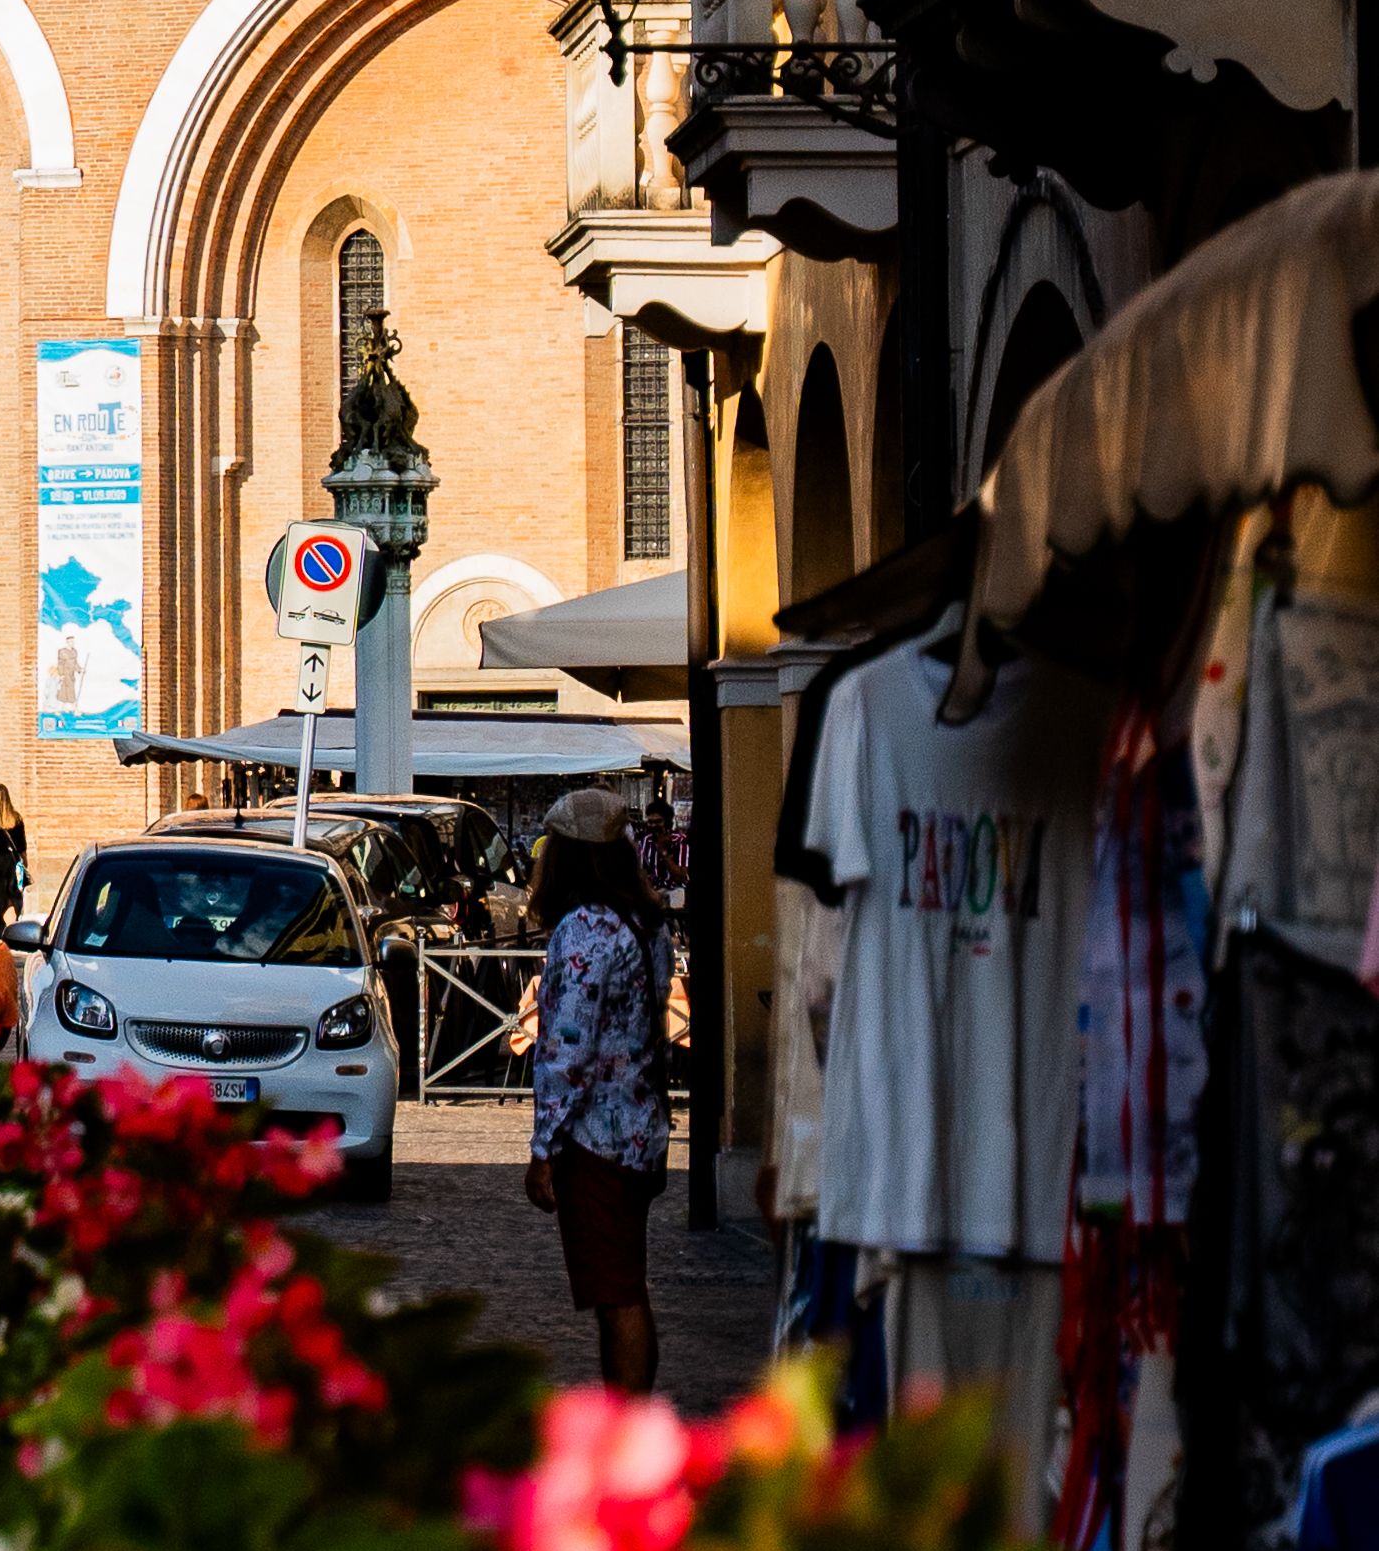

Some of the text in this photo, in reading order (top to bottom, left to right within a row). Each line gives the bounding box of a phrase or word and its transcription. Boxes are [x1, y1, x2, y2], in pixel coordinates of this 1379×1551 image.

[54, 401, 126, 435] EN ROUTE
[94, 467, 131, 480] PADOVA
[898, 808, 1046, 918] PADOVA
